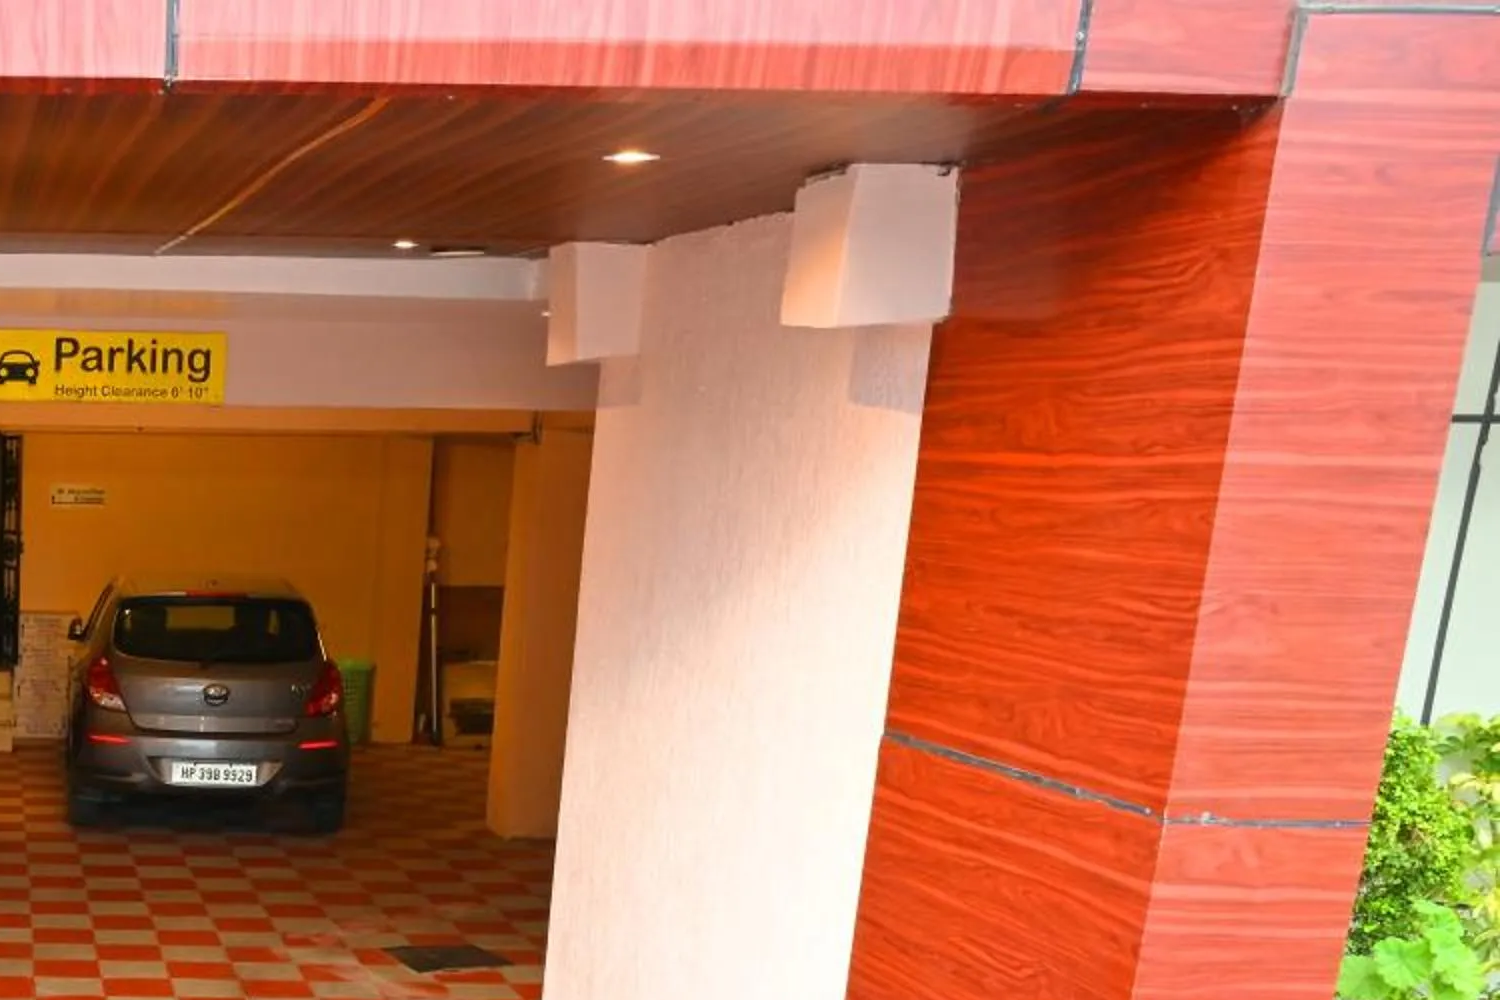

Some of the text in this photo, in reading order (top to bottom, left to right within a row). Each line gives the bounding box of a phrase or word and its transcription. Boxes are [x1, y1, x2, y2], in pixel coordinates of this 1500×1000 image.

[54, 337, 211, 383] Parking
[54, 385, 97, 398] Height
[101, 385, 168, 398] Clearance
[181, 766, 196, 779] HP
